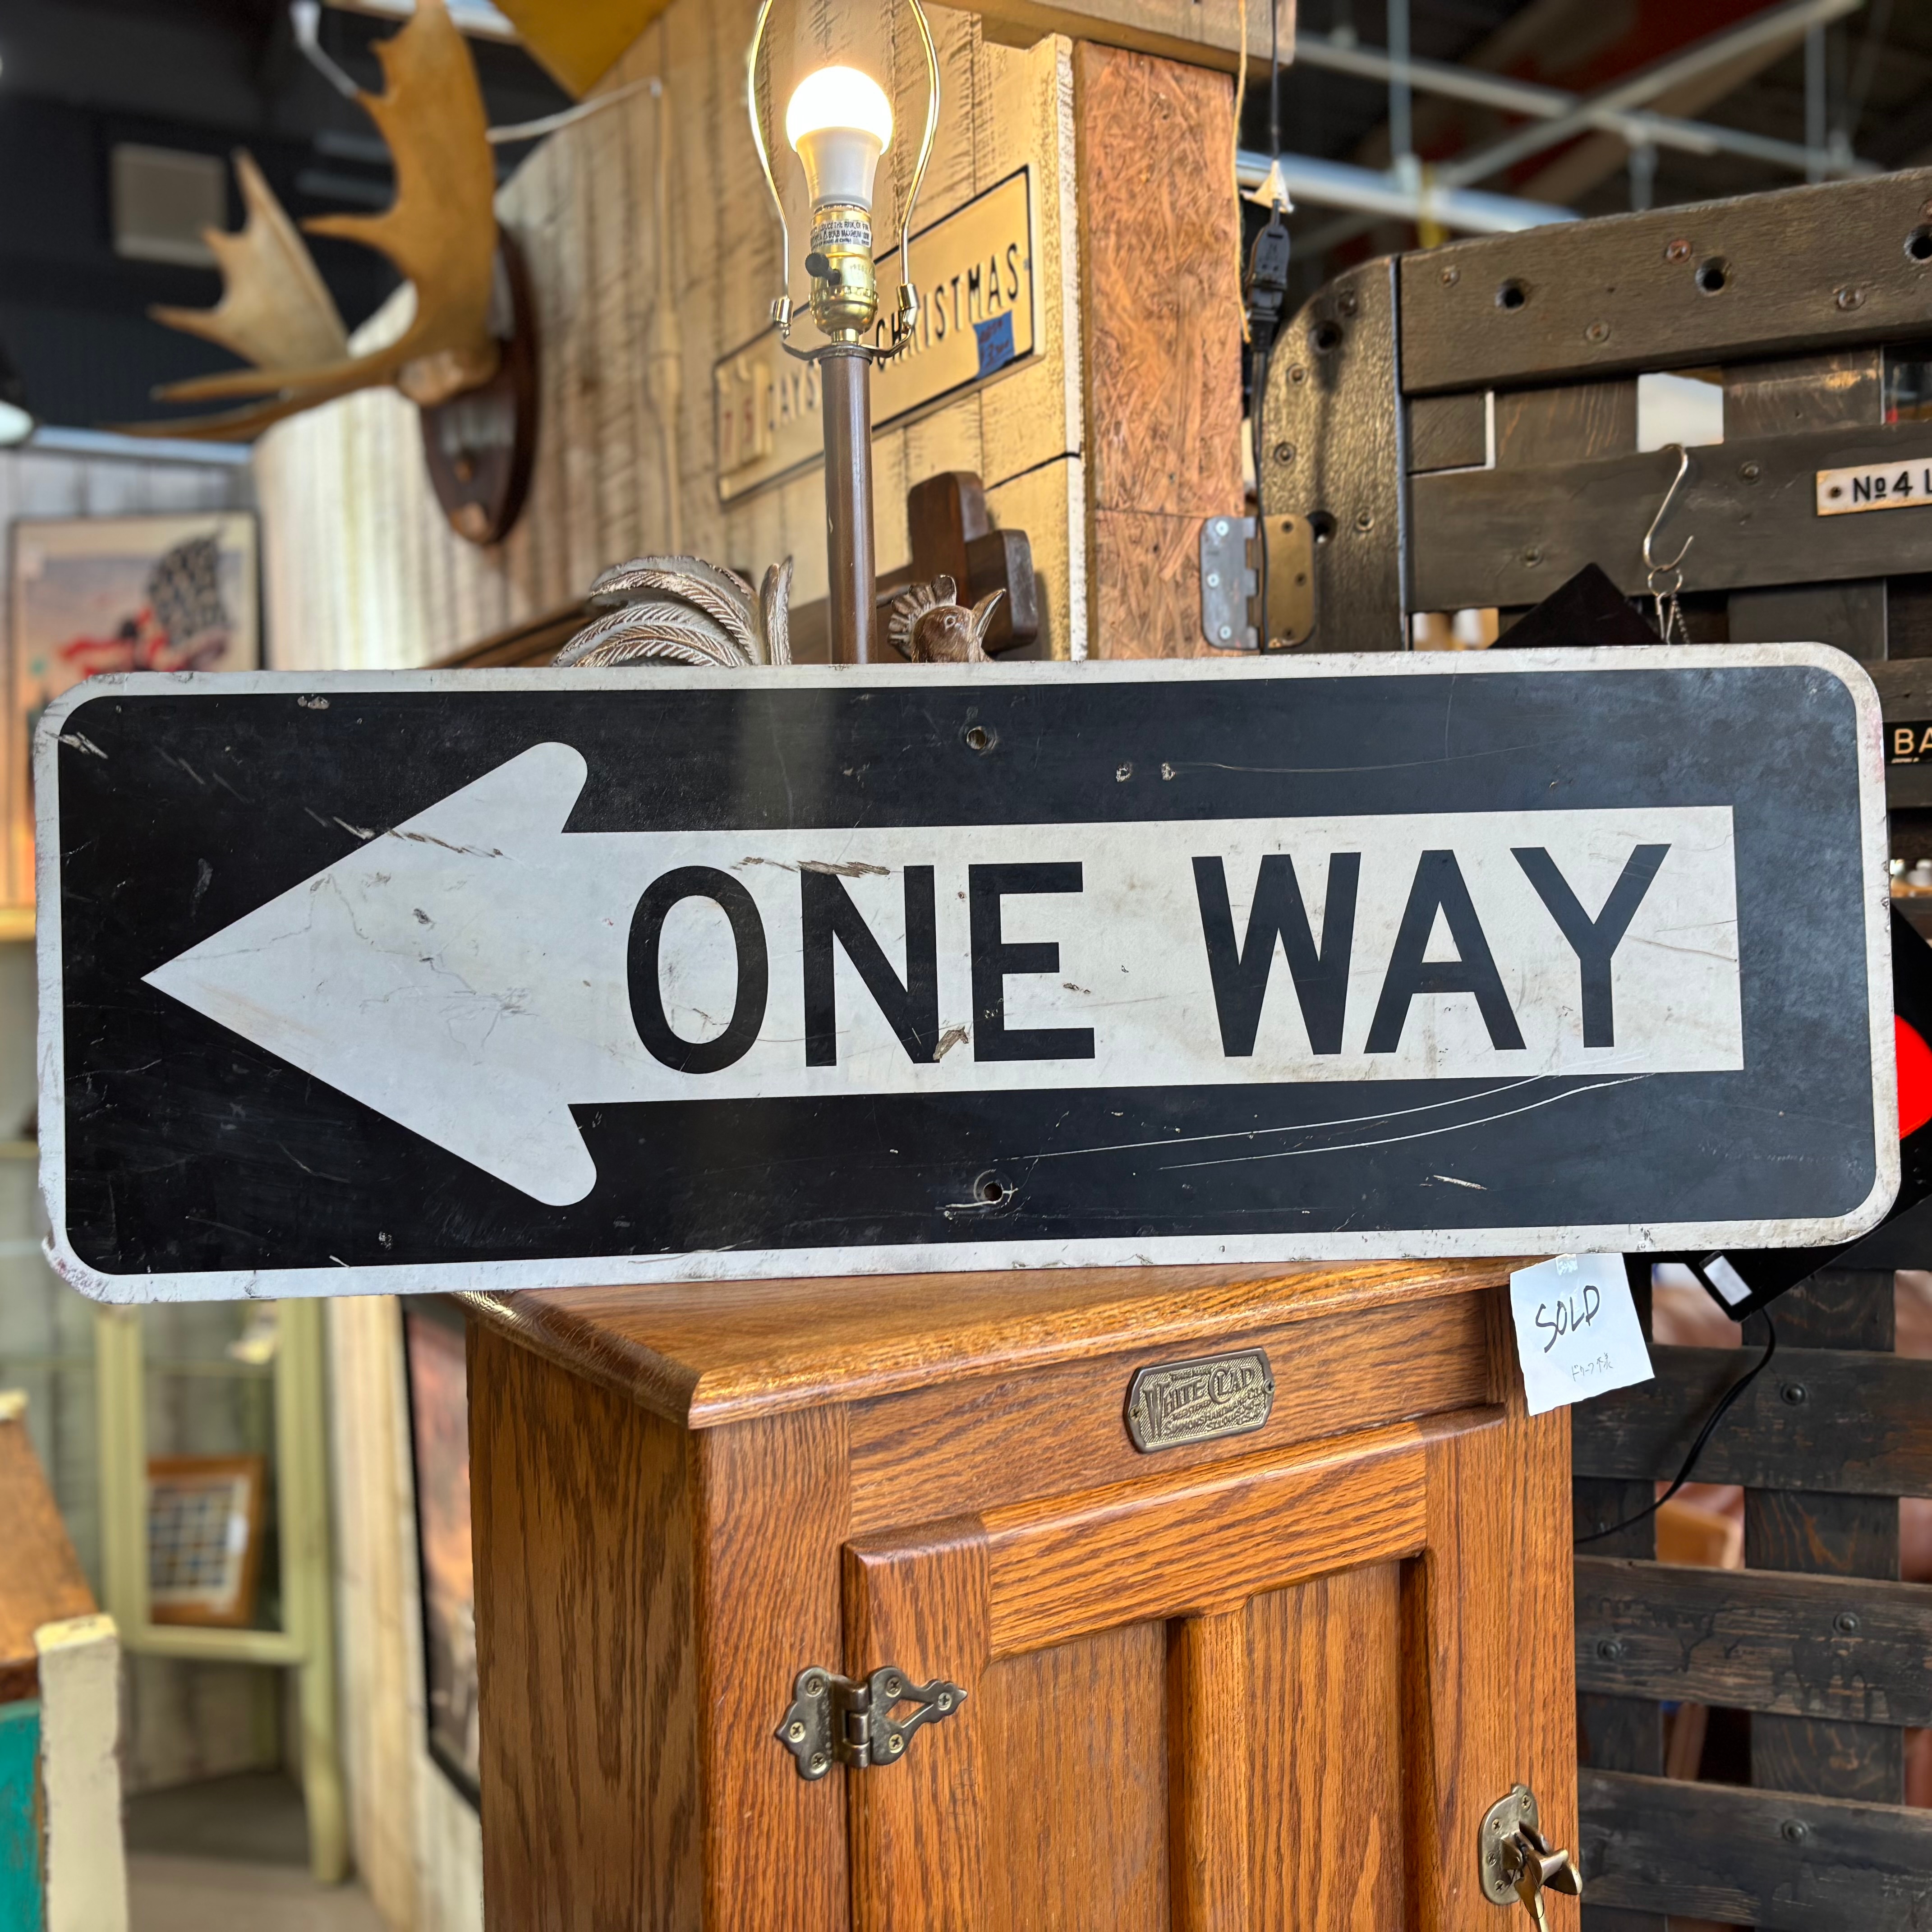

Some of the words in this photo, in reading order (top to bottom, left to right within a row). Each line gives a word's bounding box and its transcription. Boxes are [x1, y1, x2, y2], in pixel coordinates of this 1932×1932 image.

[627, 861, 1095, 1074] ONE
[1191, 844, 1671, 1057] WAY
[1535, 1285, 1600, 1353] SOLD
[1143, 1376, 1206, 1438] WHITE
[1208, 1366, 1255, 1404] CLAD
